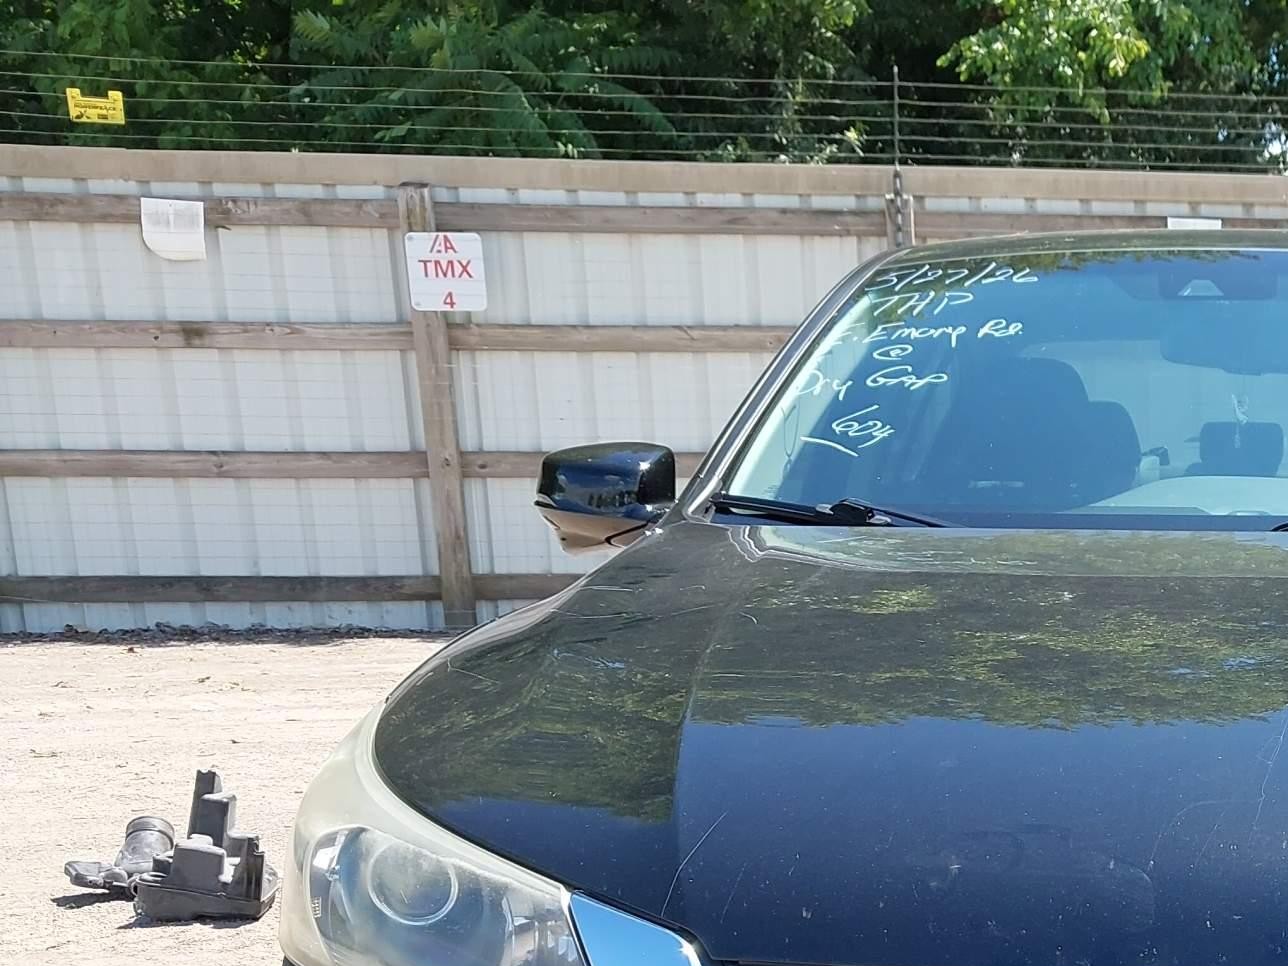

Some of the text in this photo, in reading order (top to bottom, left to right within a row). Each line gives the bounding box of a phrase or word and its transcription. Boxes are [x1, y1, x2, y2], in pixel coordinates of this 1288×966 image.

[418, 259, 473, 279] TMX
[864, 262, 1039, 292] 5/27/26
[443, 291, 457, 309] 4
[871, 291, 975, 317] THP
[977, 318, 1024, 339] Rd.
